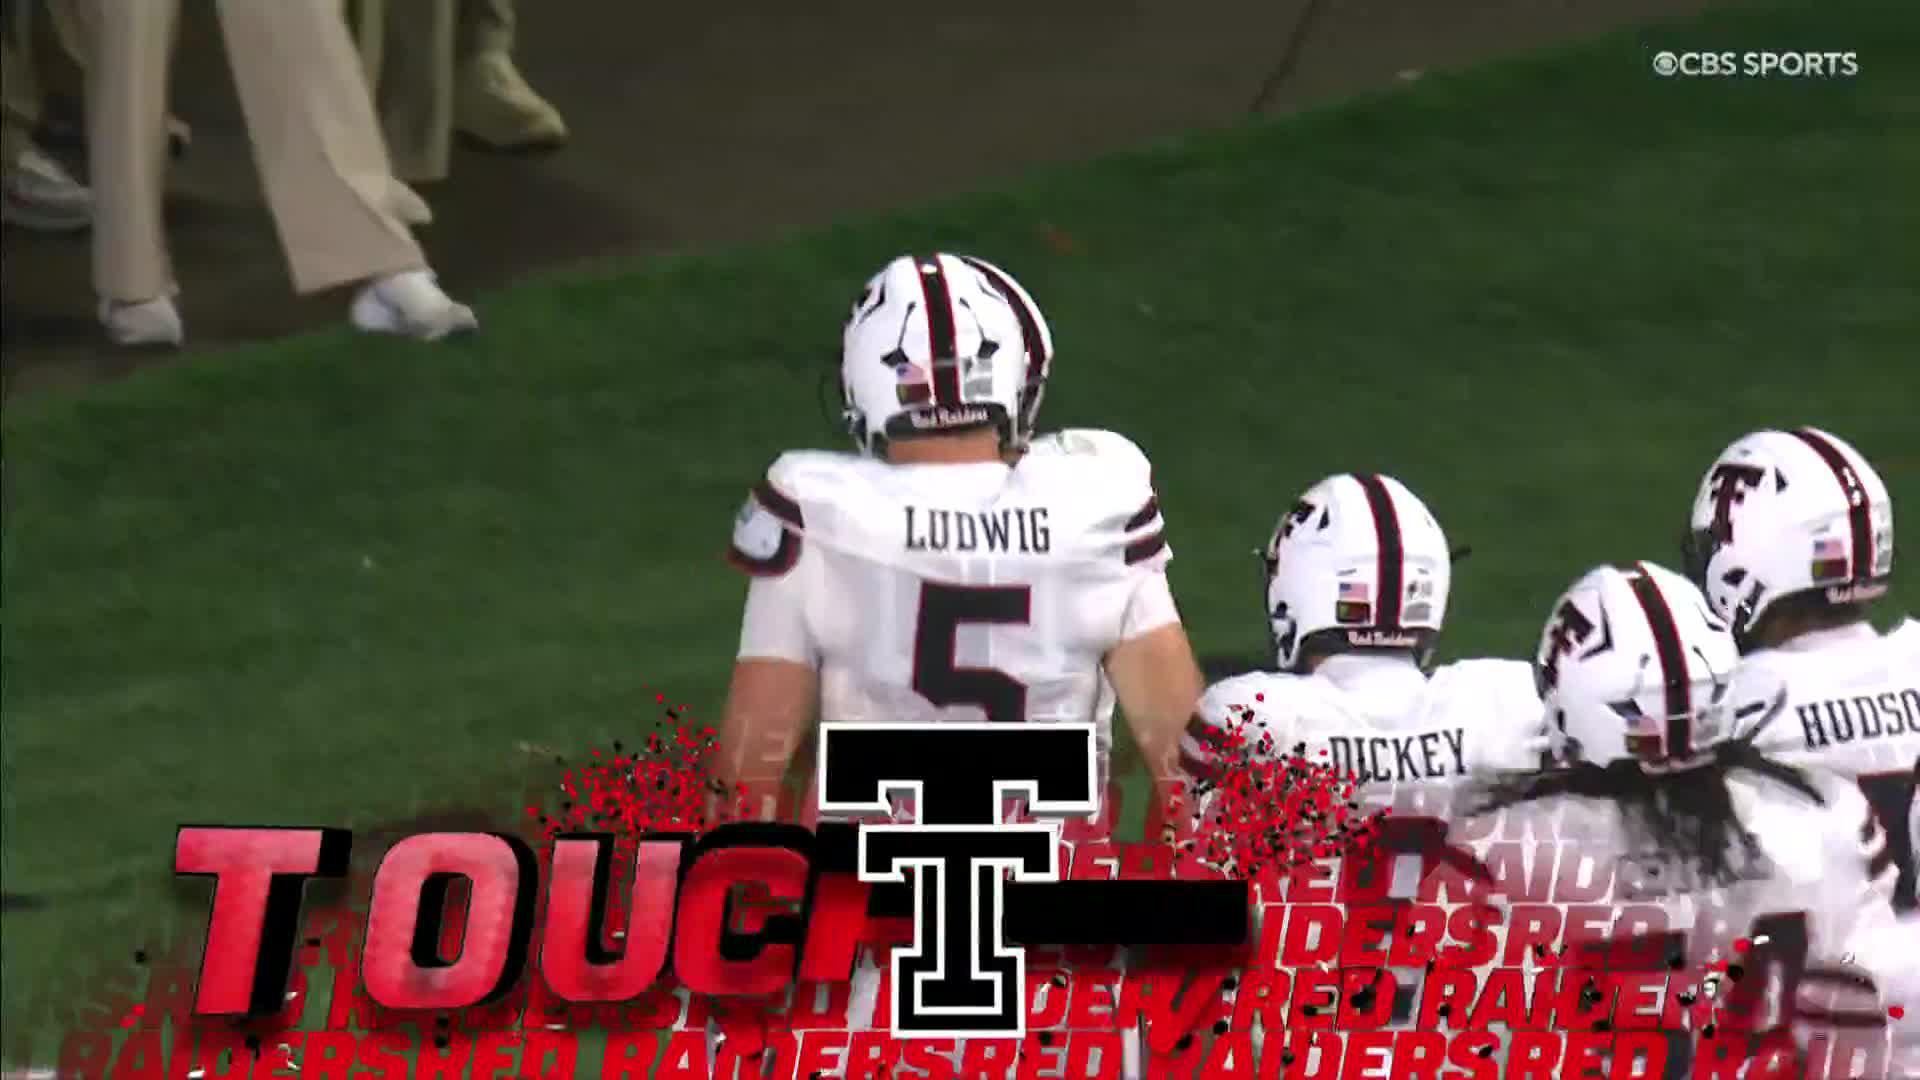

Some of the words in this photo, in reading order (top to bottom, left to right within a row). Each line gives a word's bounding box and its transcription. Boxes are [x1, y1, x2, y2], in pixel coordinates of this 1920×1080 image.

[905, 505, 1050, 554] LUDWIG
[912, 579, 1031, 722] 5
[1795, 688, 1920, 750] HUDSO
[1328, 727, 1466, 785] DICKEY
